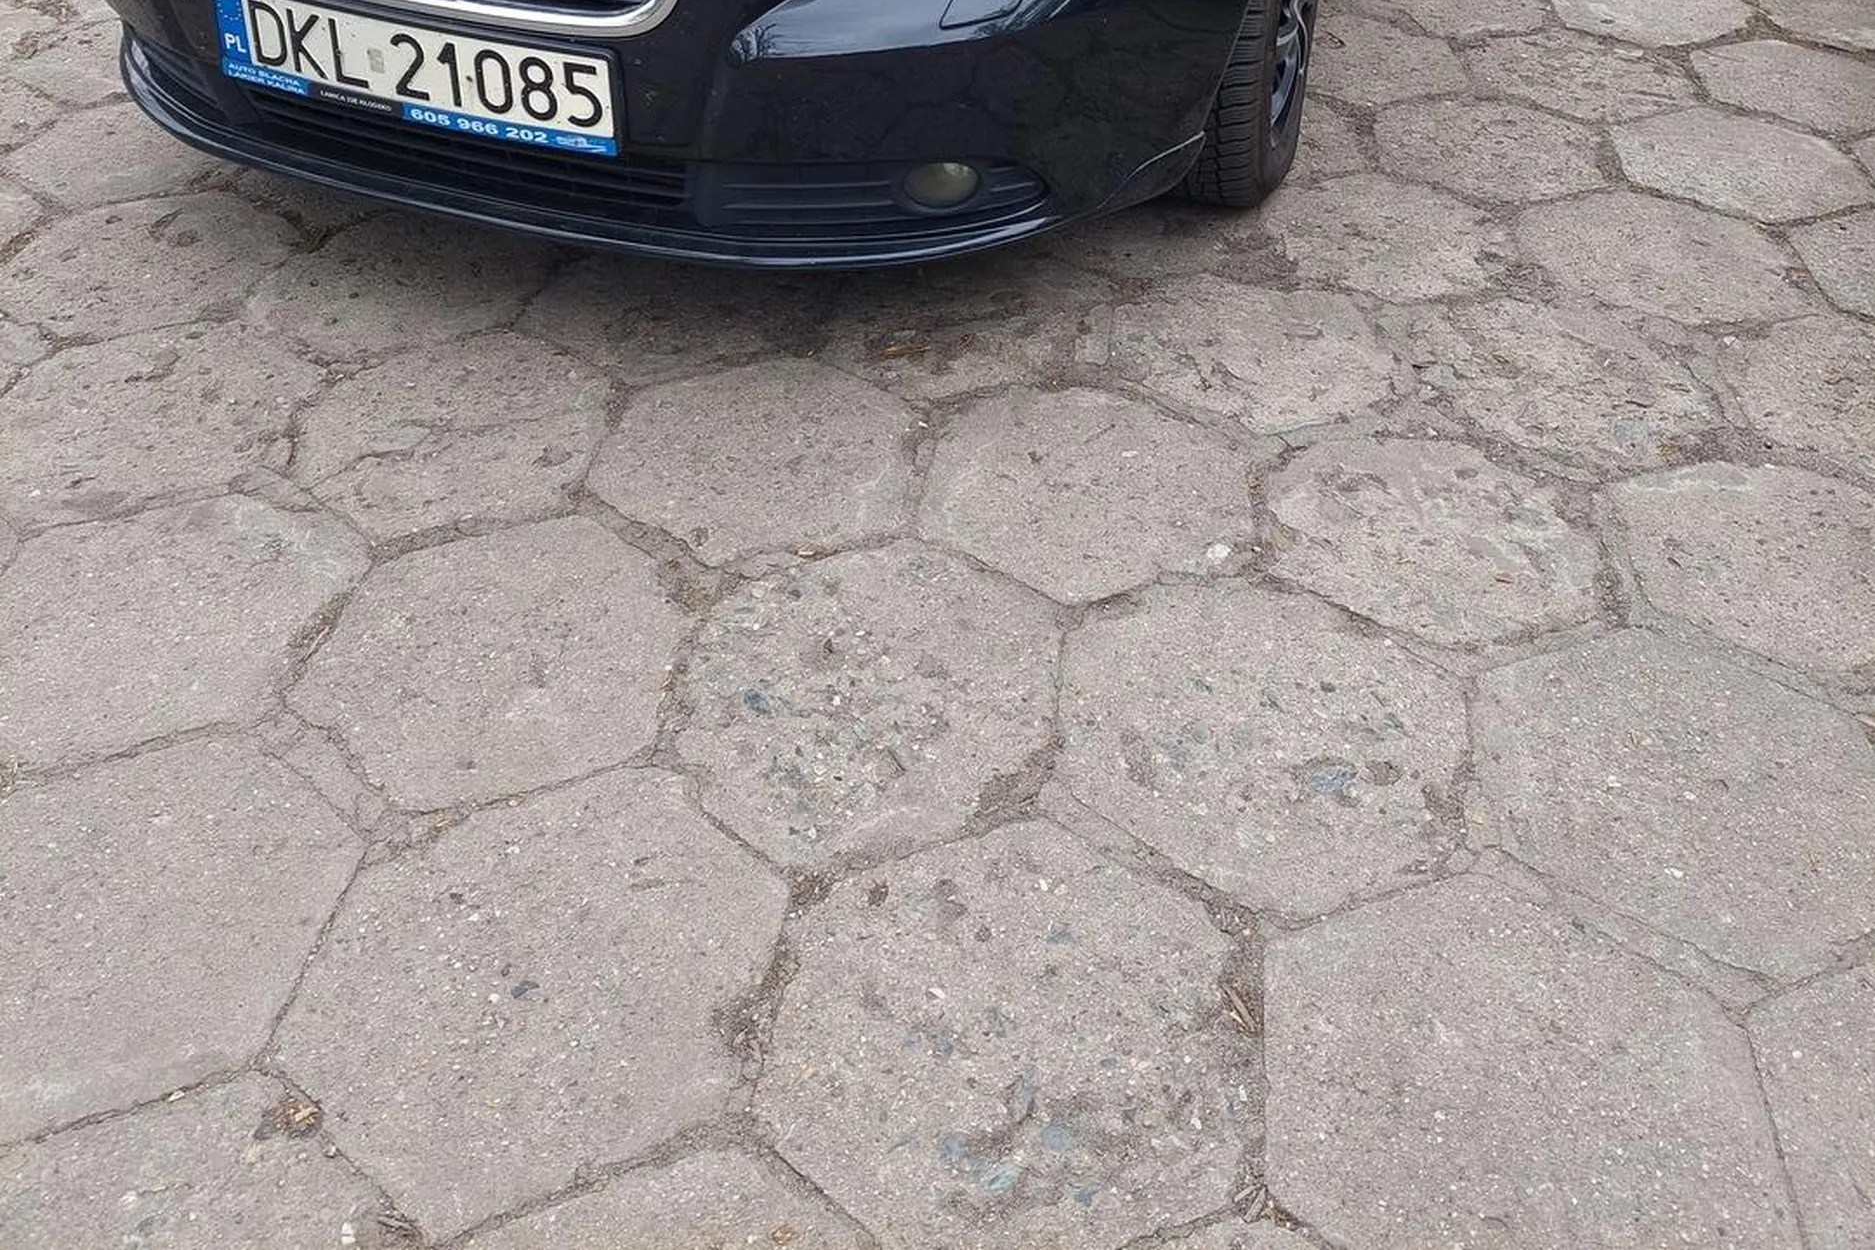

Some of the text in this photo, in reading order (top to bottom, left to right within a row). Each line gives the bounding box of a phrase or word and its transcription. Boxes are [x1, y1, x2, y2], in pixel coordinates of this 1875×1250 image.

[224, 33, 246, 54] PL
[248, 0, 603, 128] DKL 21085
[411, 108, 549, 143] 605 966 202
